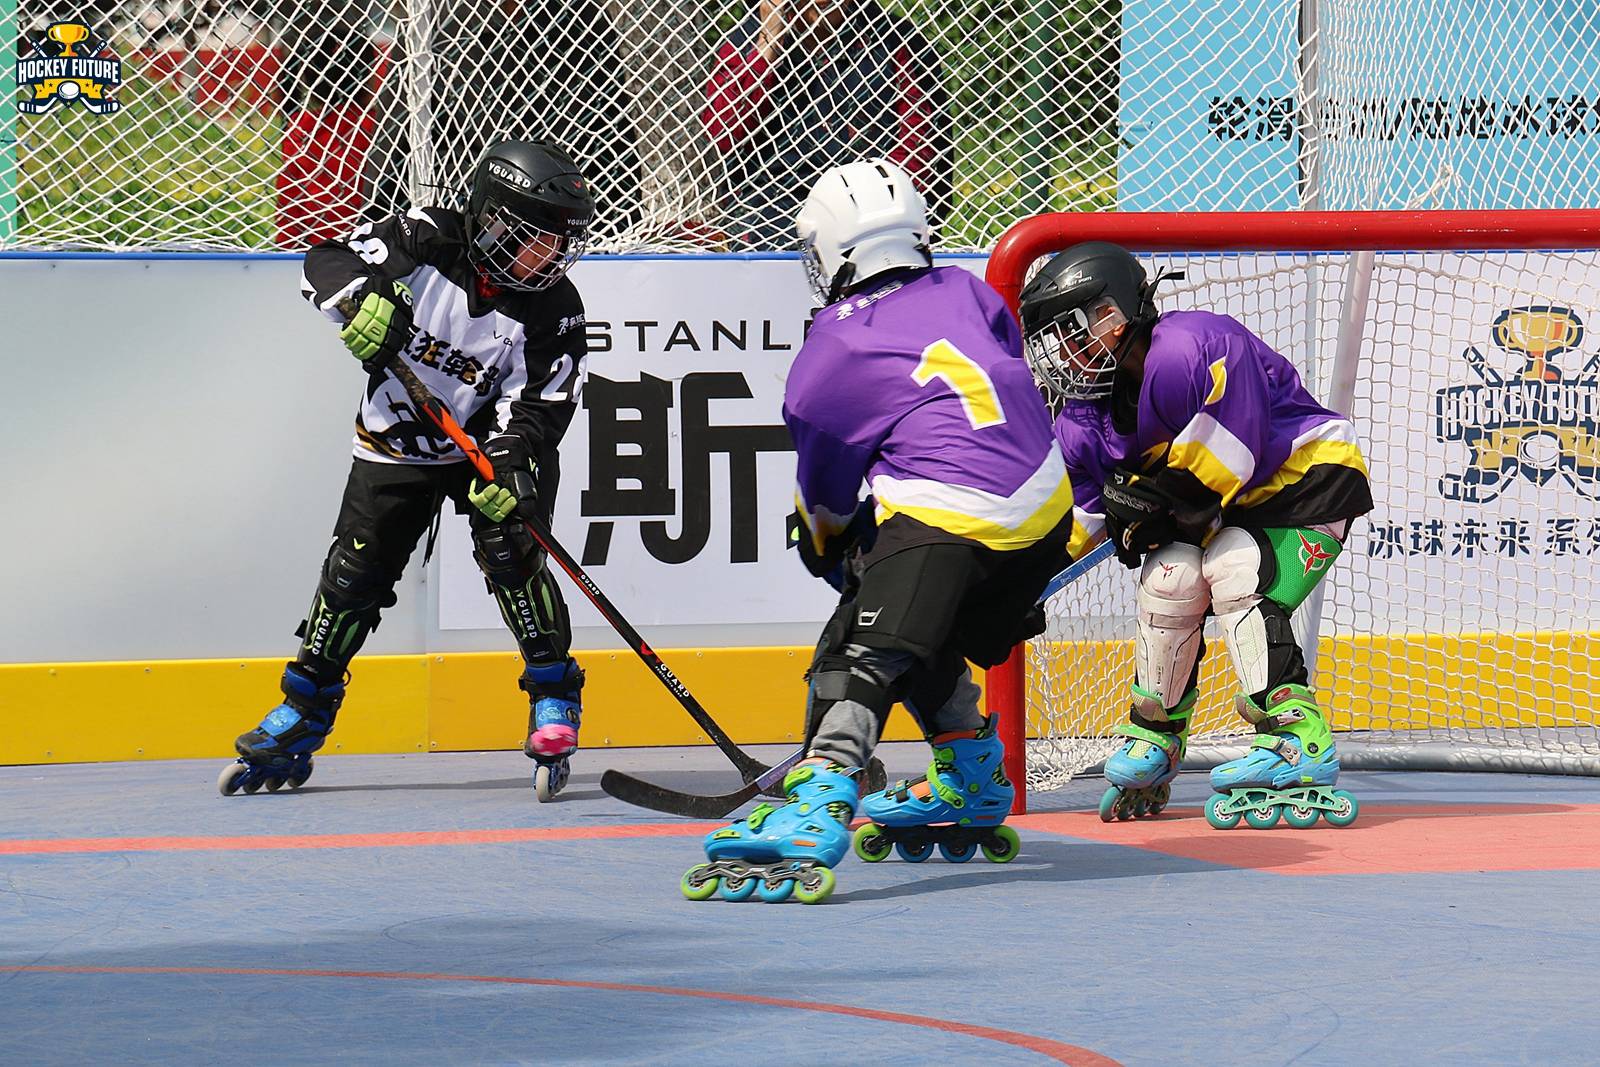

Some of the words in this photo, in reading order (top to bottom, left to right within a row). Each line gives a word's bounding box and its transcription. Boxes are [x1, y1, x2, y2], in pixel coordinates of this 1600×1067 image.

[586, 319, 813, 352] STANL
[910, 338, 1007, 430] 1
[1441, 384, 1538, 436] HOCKEY
